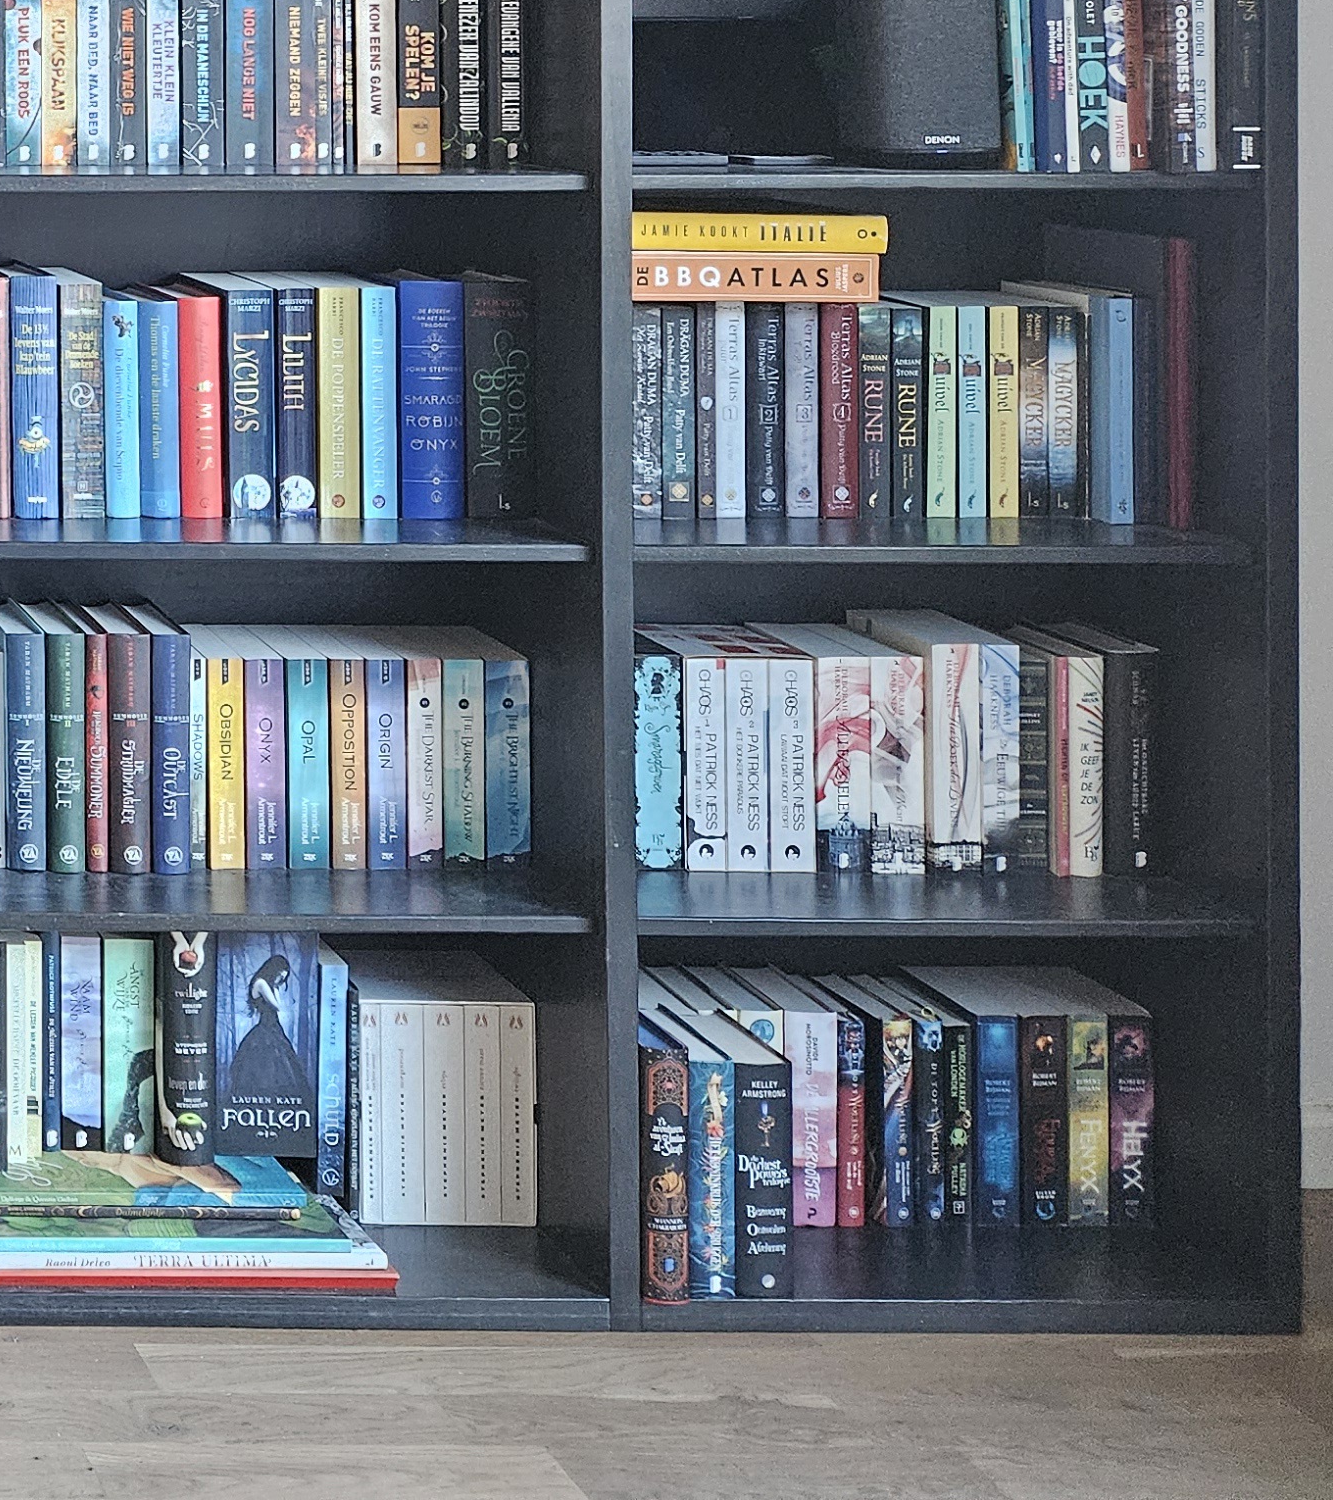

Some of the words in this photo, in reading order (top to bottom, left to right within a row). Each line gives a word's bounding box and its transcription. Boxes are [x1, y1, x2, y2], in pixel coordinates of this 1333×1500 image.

[367, 3, 381, 32] KOM
[50, 19, 67, 111] KLIKSPAAN
[368, 35, 381, 71] EENS
[405, 25, 420, 100] SPELEN?
[420, 31, 435, 68] KOM
[1174, 6, 1190, 92] GOODNESS
[369, 75, 382, 116] GAUW
[420, 73, 435, 92] JE
[1077, 35, 1109, 130] HOEK
[924, 135, 960, 144] DENON
[636, 266, 649, 286] DE
[727, 266, 829, 287] ATLAS
[232, 331, 260, 433] LYCIDAS
[280, 332, 311, 411] LILITH
[471, 371, 508, 474] BLOEM
[864, 378, 884, 443] RUNE
[897, 383, 917, 448] RUNE
[408, 438, 458, 451] ONYX
[218, 704, 235, 781] OBSIDIAN
[256, 718, 275, 765] ONYX
[300, 720, 317, 765] OPAL
[704, 733, 717, 790] PATRICK
[746, 733, 759, 791] PATRICK
[791, 734, 804, 791] PATRICK
[87, 746, 105, 820] SUMMONER
[161, 748, 182, 820] OUTCAST
[705, 793, 717, 830] NESS
[747, 794, 760, 831] NESS
[792, 794, 805, 831] NESS
[68, 988, 82, 1023] WIND
[741, 1089, 786, 1099] ARMSTRONG
[751, 1080, 779, 1088] KELLEY
[1079, 1119, 1101, 1191] FENYX
[1121, 1120, 1145, 1189] HELYX
[44, 1256, 77, 1268] Raoul
[133, 1255, 192, 1267] TERRA
[201, 1254, 269, 1267] ULTIMA
